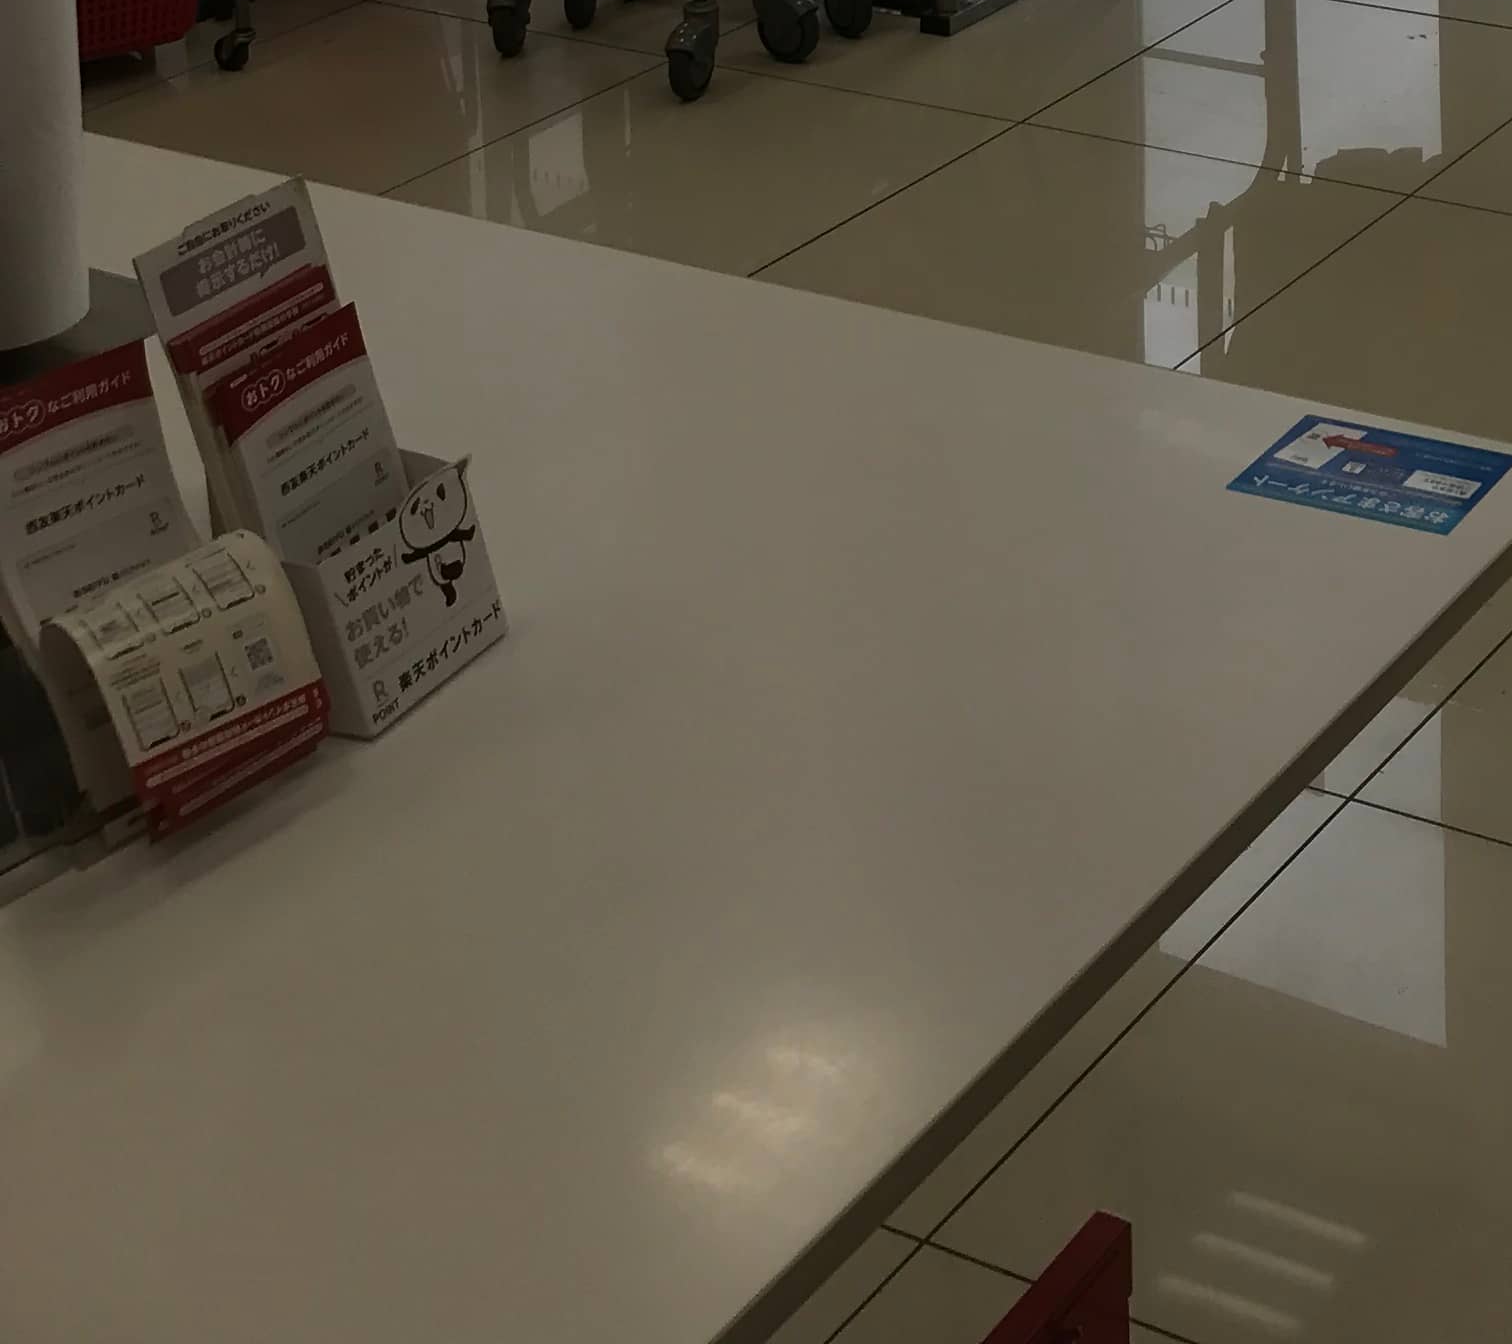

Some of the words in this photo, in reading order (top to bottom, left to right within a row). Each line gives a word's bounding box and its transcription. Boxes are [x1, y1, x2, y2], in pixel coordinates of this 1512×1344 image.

[346, 555, 393, 603] ポイントが
[398, 601, 502, 692] 楽天ポイントカード
[372, 699, 402, 726] POINT
